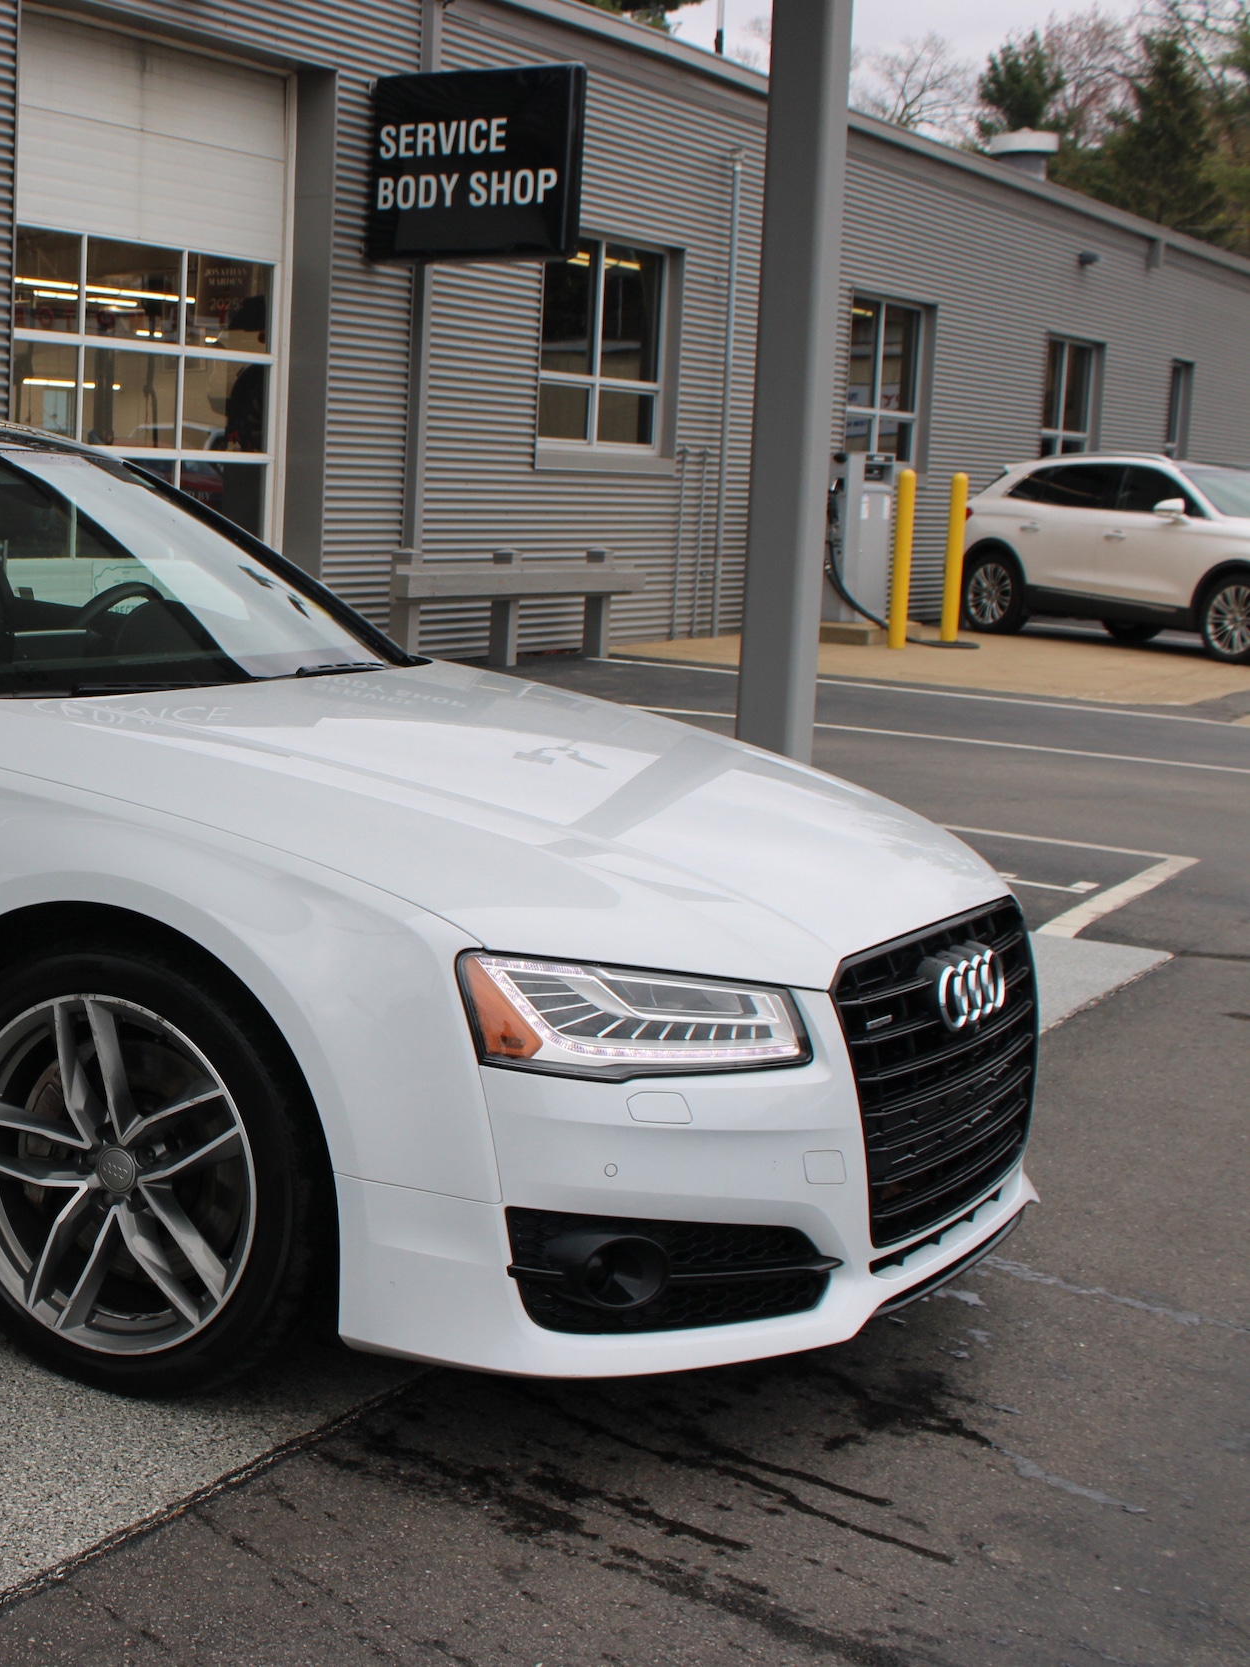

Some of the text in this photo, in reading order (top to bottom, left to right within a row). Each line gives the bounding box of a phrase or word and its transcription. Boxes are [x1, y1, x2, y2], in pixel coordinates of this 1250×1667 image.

[379, 117, 508, 160] SERVICE
[377, 168, 558, 211] BODY SHOP
